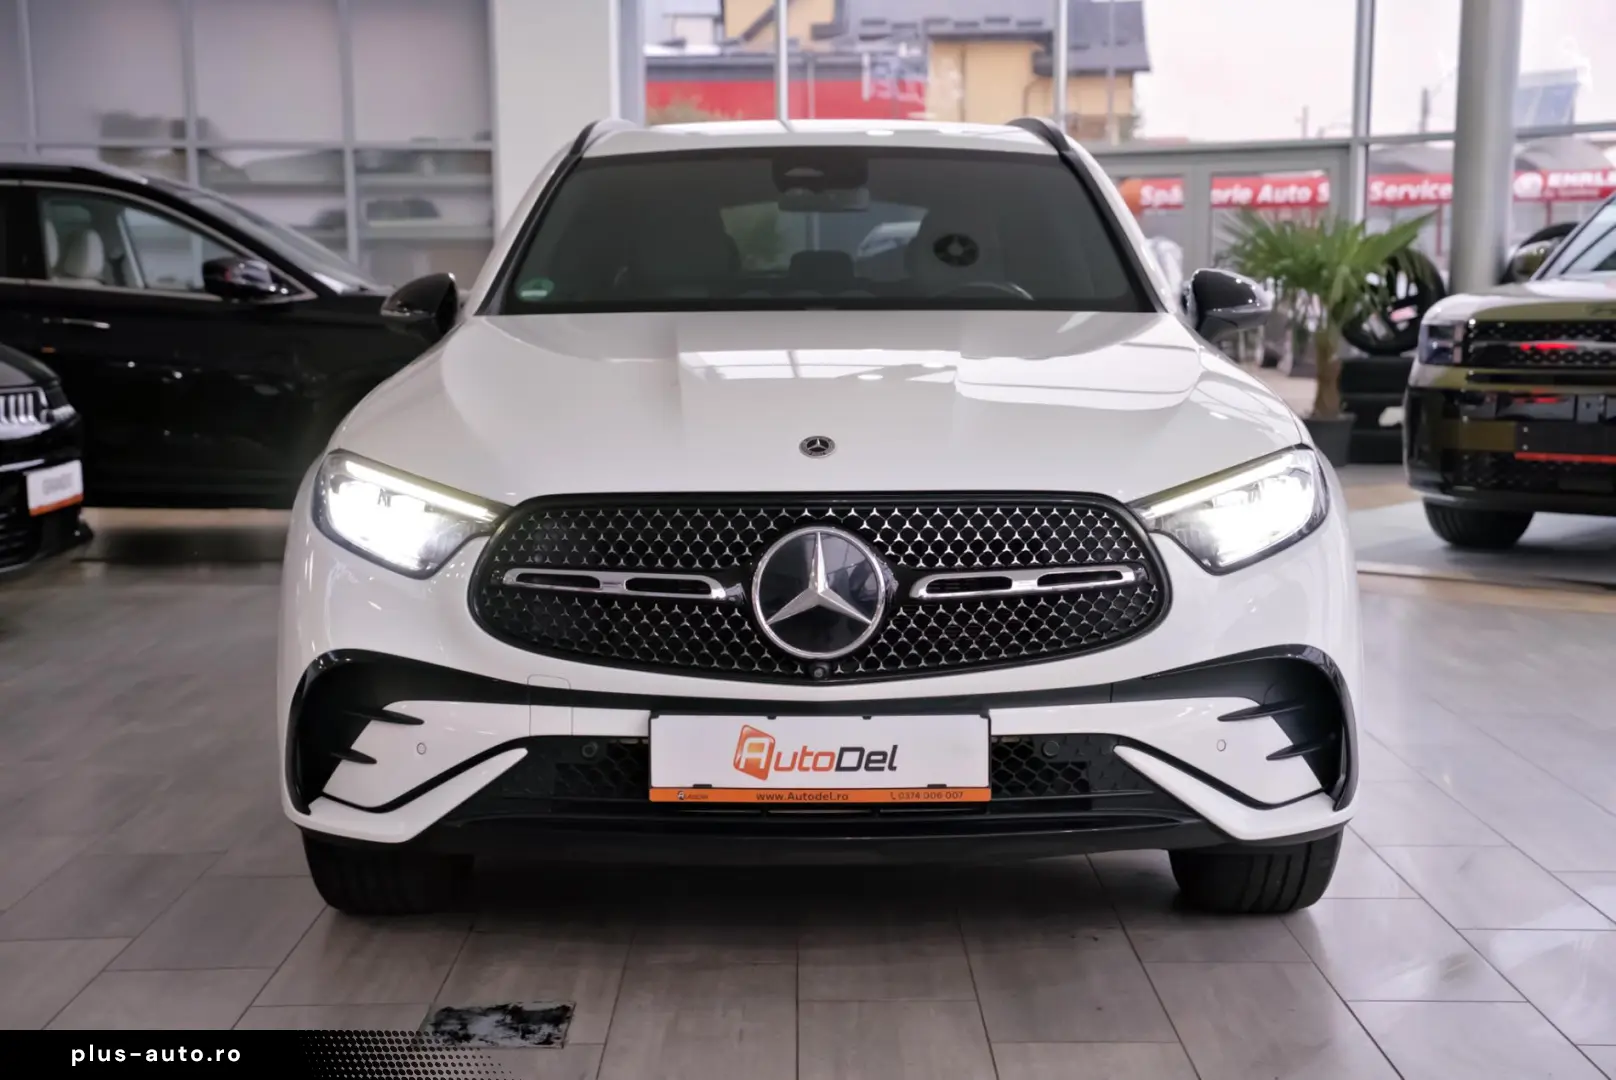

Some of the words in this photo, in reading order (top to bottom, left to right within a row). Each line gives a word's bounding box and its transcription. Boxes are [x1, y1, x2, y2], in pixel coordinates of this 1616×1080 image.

[1257, 184, 1313, 204] Auto
[1370, 179, 1453, 201] Service
[738, 736, 898, 772] AutoDel
[756, 791, 849, 801] www.Autodel.ro
